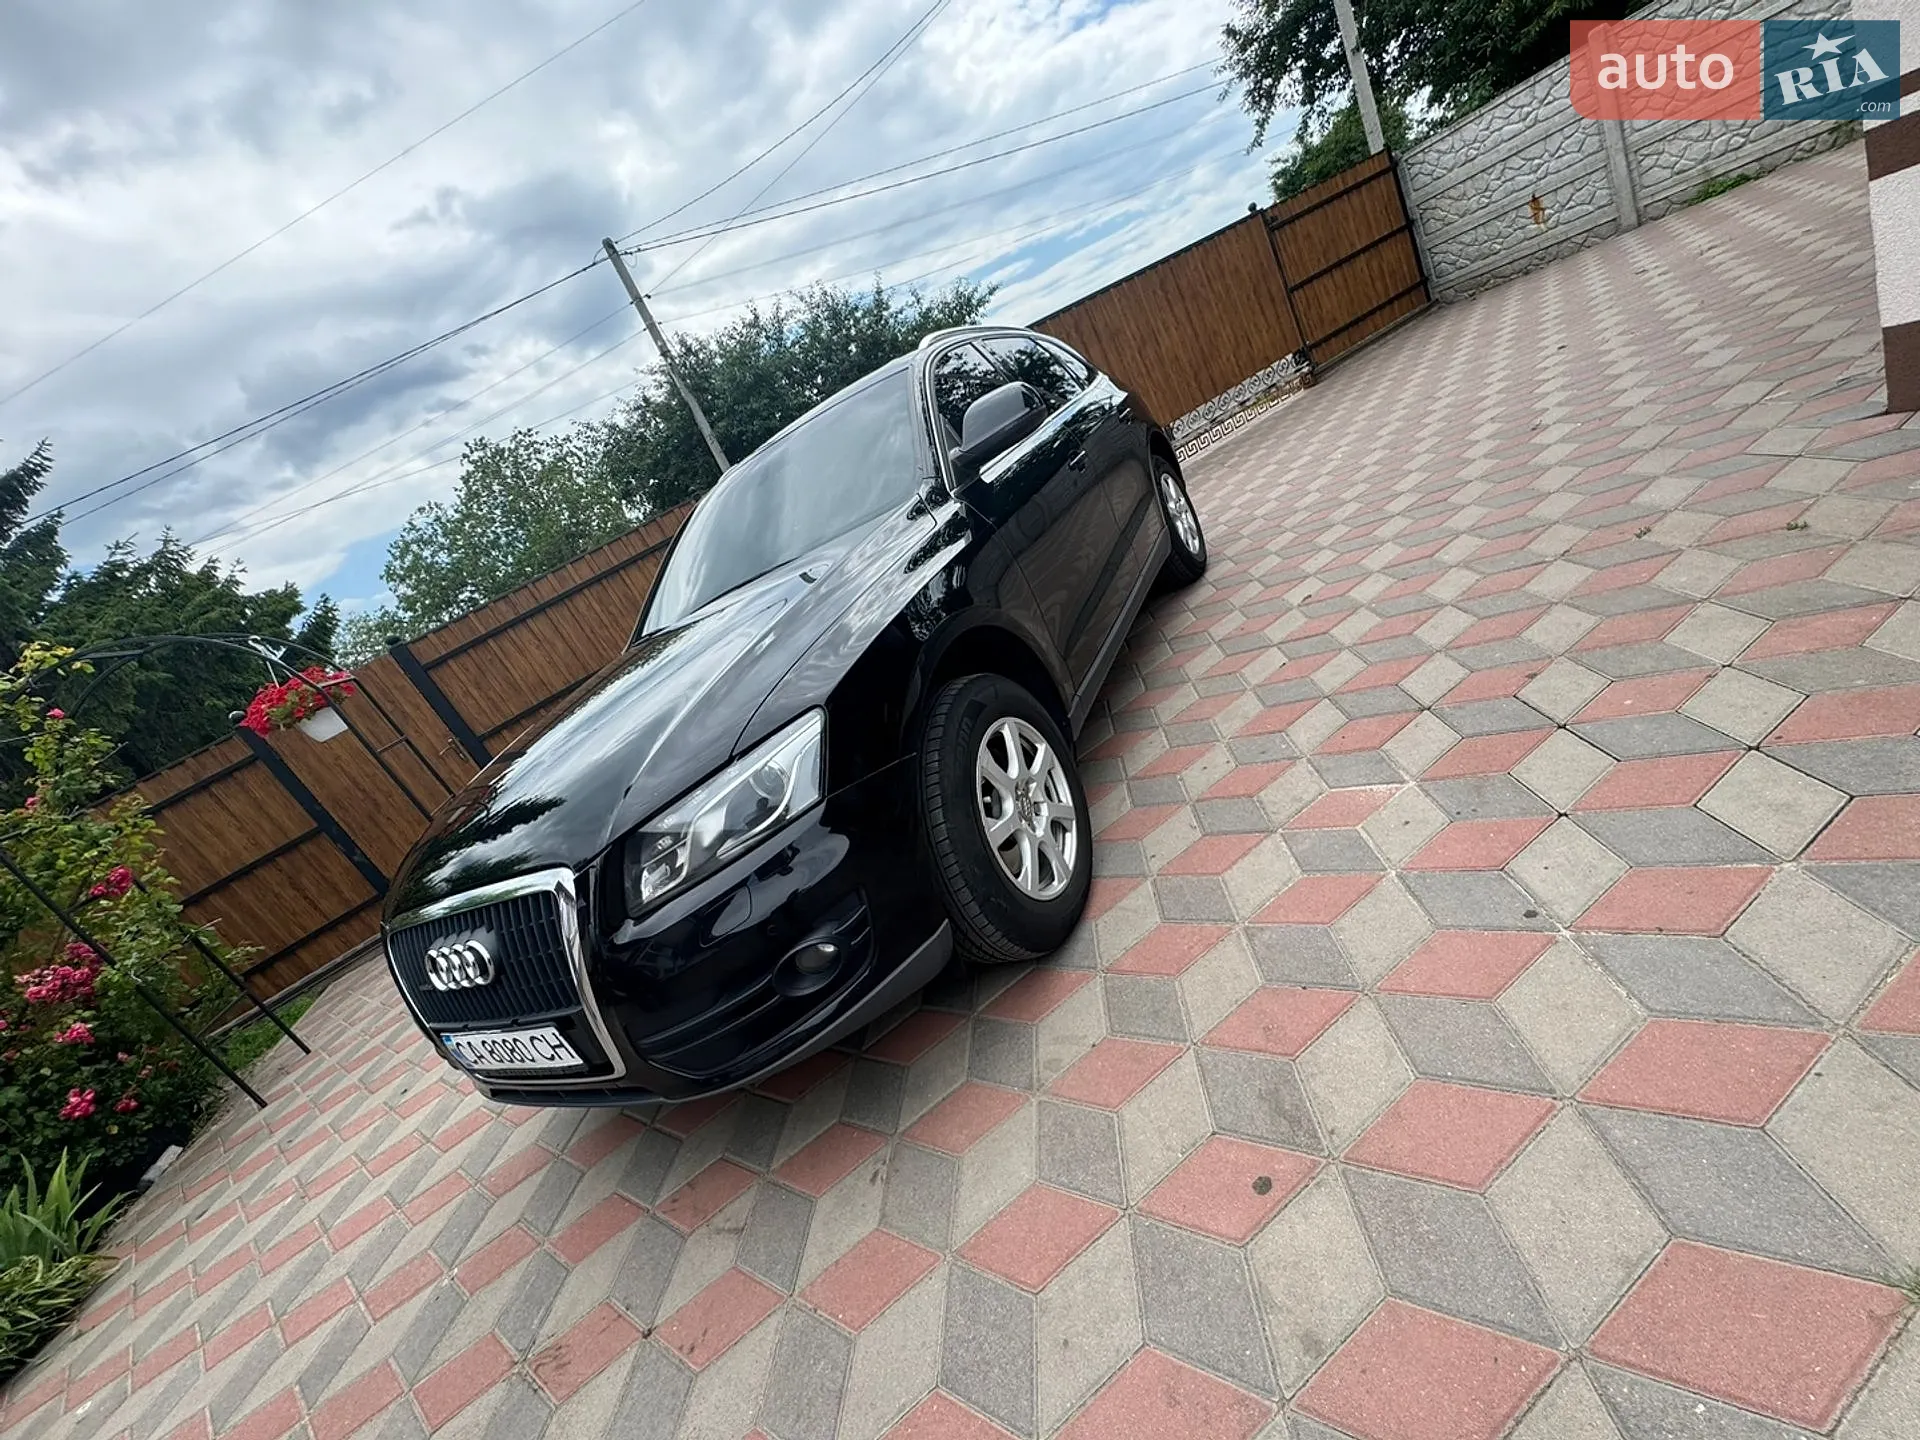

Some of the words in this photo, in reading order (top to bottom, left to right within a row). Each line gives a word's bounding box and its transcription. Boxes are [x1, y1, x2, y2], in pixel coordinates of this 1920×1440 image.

[455, 1041, 490, 1065] CA
[481, 1037, 536, 1063] 8080
[529, 1032, 575, 1061] CH
